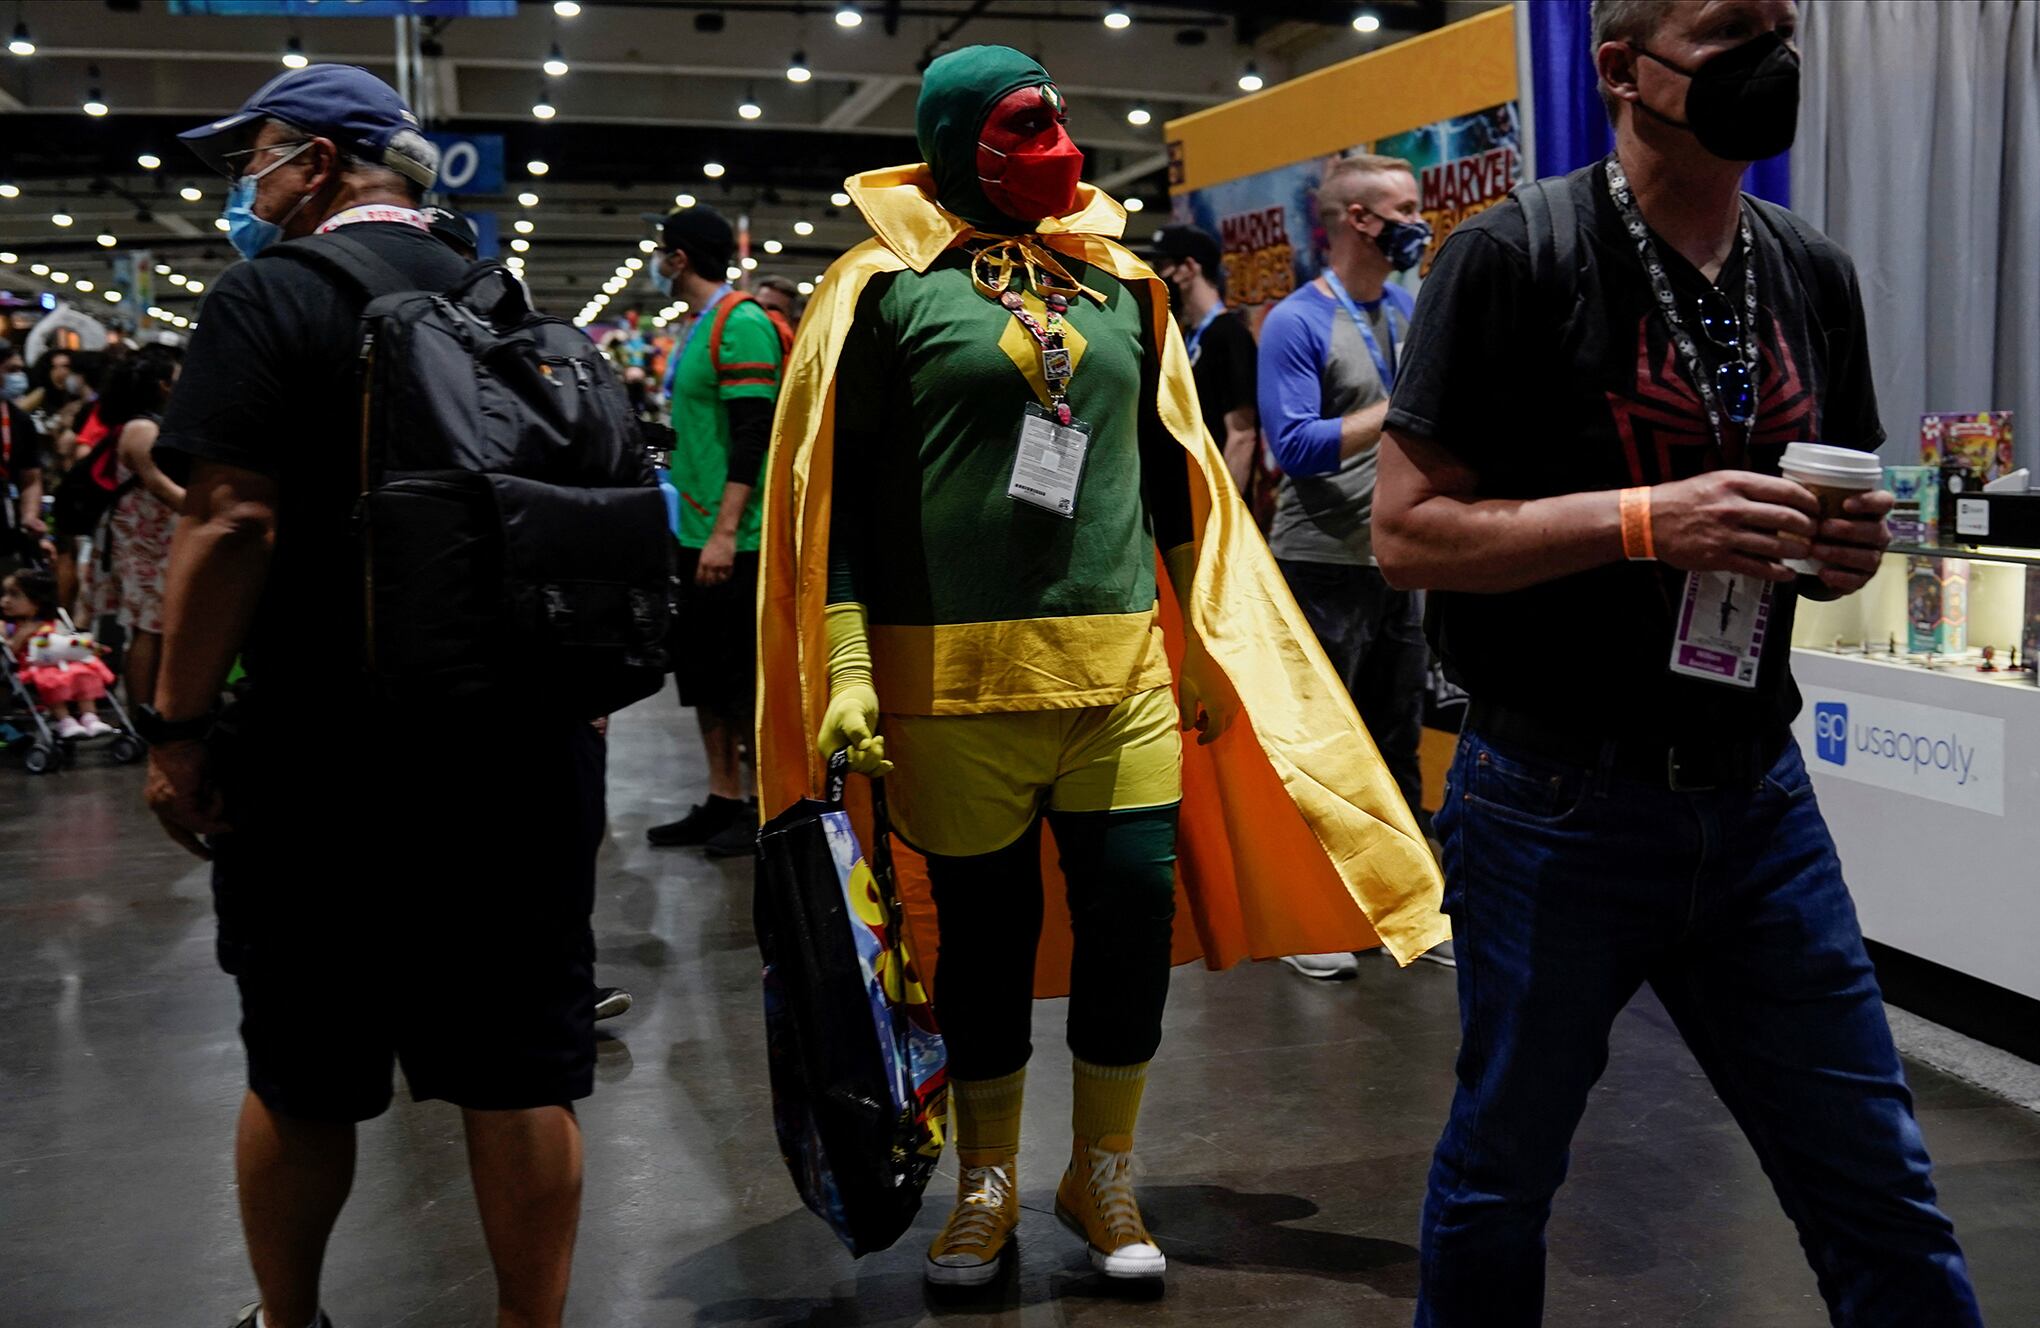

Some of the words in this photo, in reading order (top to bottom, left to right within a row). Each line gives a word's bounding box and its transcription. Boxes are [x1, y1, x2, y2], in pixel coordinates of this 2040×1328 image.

[1421, 150, 1514, 213] MARVEL
[1221, 206, 1289, 256] MARVEL
[1854, 723, 1975, 785] usaopoly
